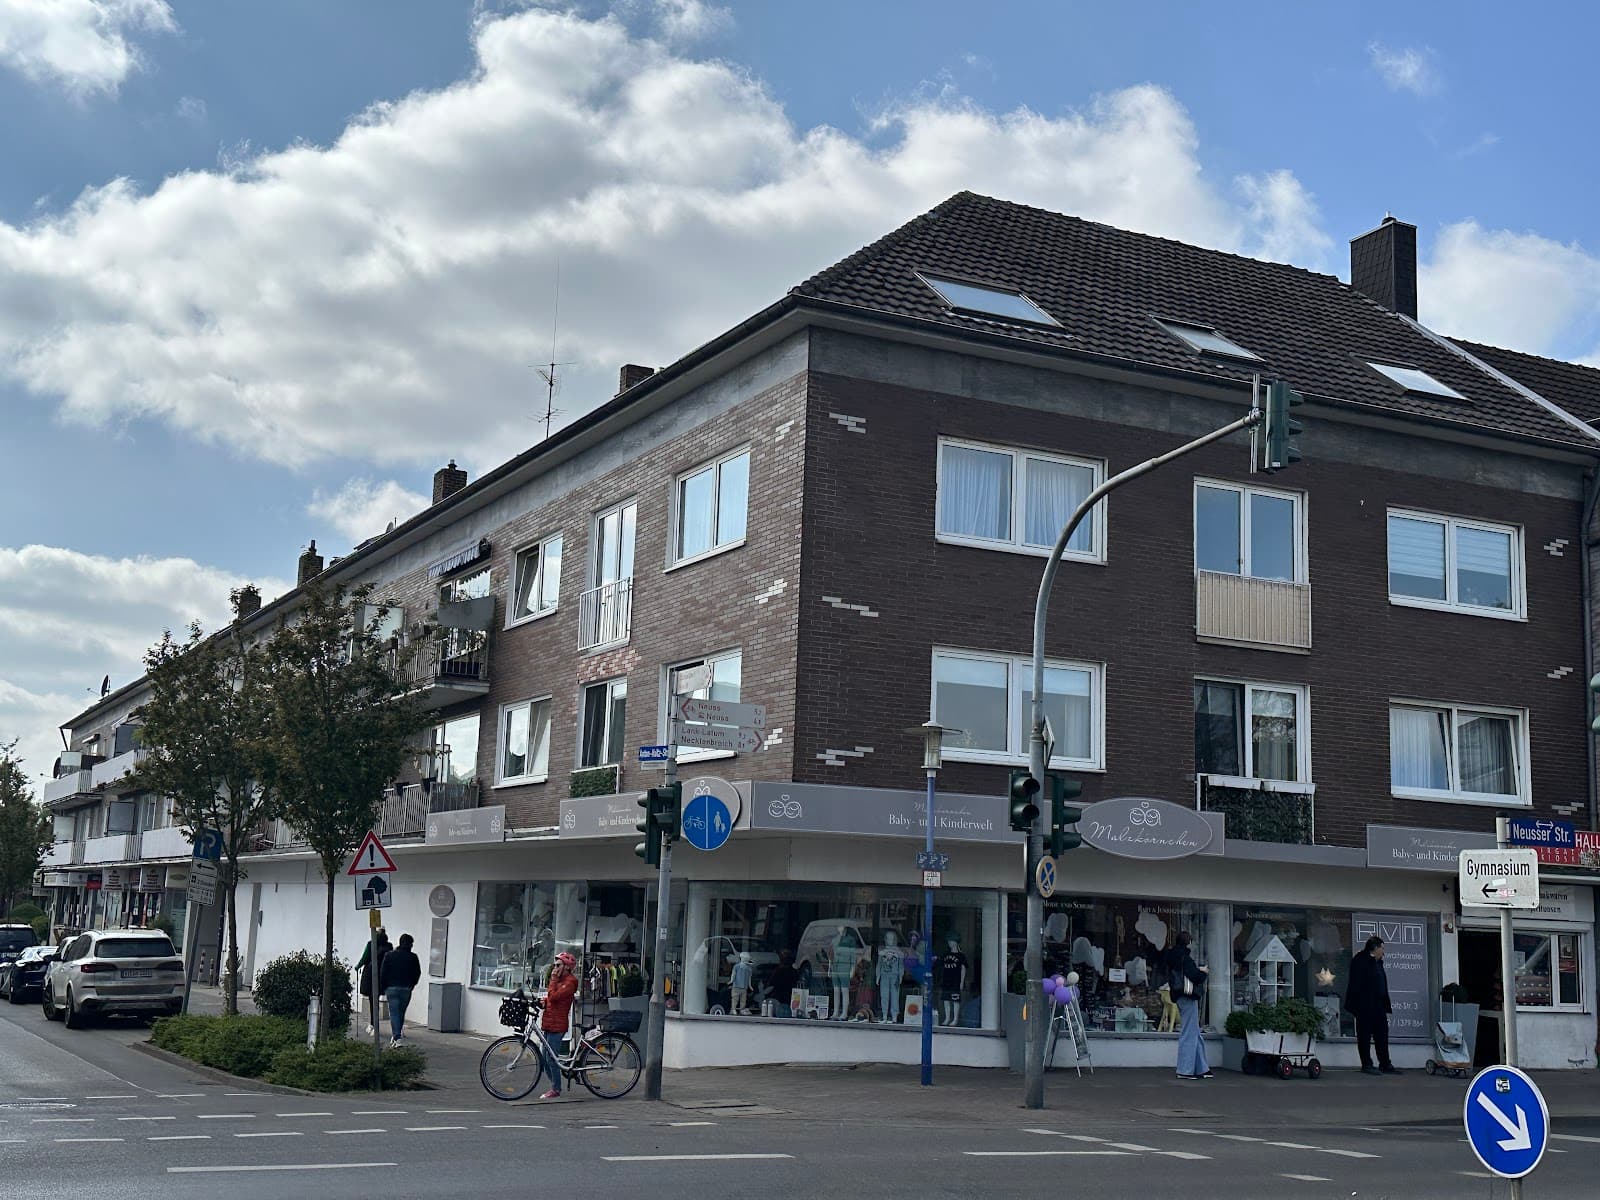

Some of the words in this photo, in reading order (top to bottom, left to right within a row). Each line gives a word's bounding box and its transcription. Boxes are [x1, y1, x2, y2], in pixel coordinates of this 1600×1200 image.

[889, 813, 917, 830] Baby-
[940, 816, 993, 831] Kinderwelt
[1512, 823, 1551, 842] Neusser
[1554, 826, 1571, 843] Str.
[1392, 847, 1414, 862] Baby-
[1416, 849, 1431, 860] und
[1466, 858, 1530, 879] Gymnasium
